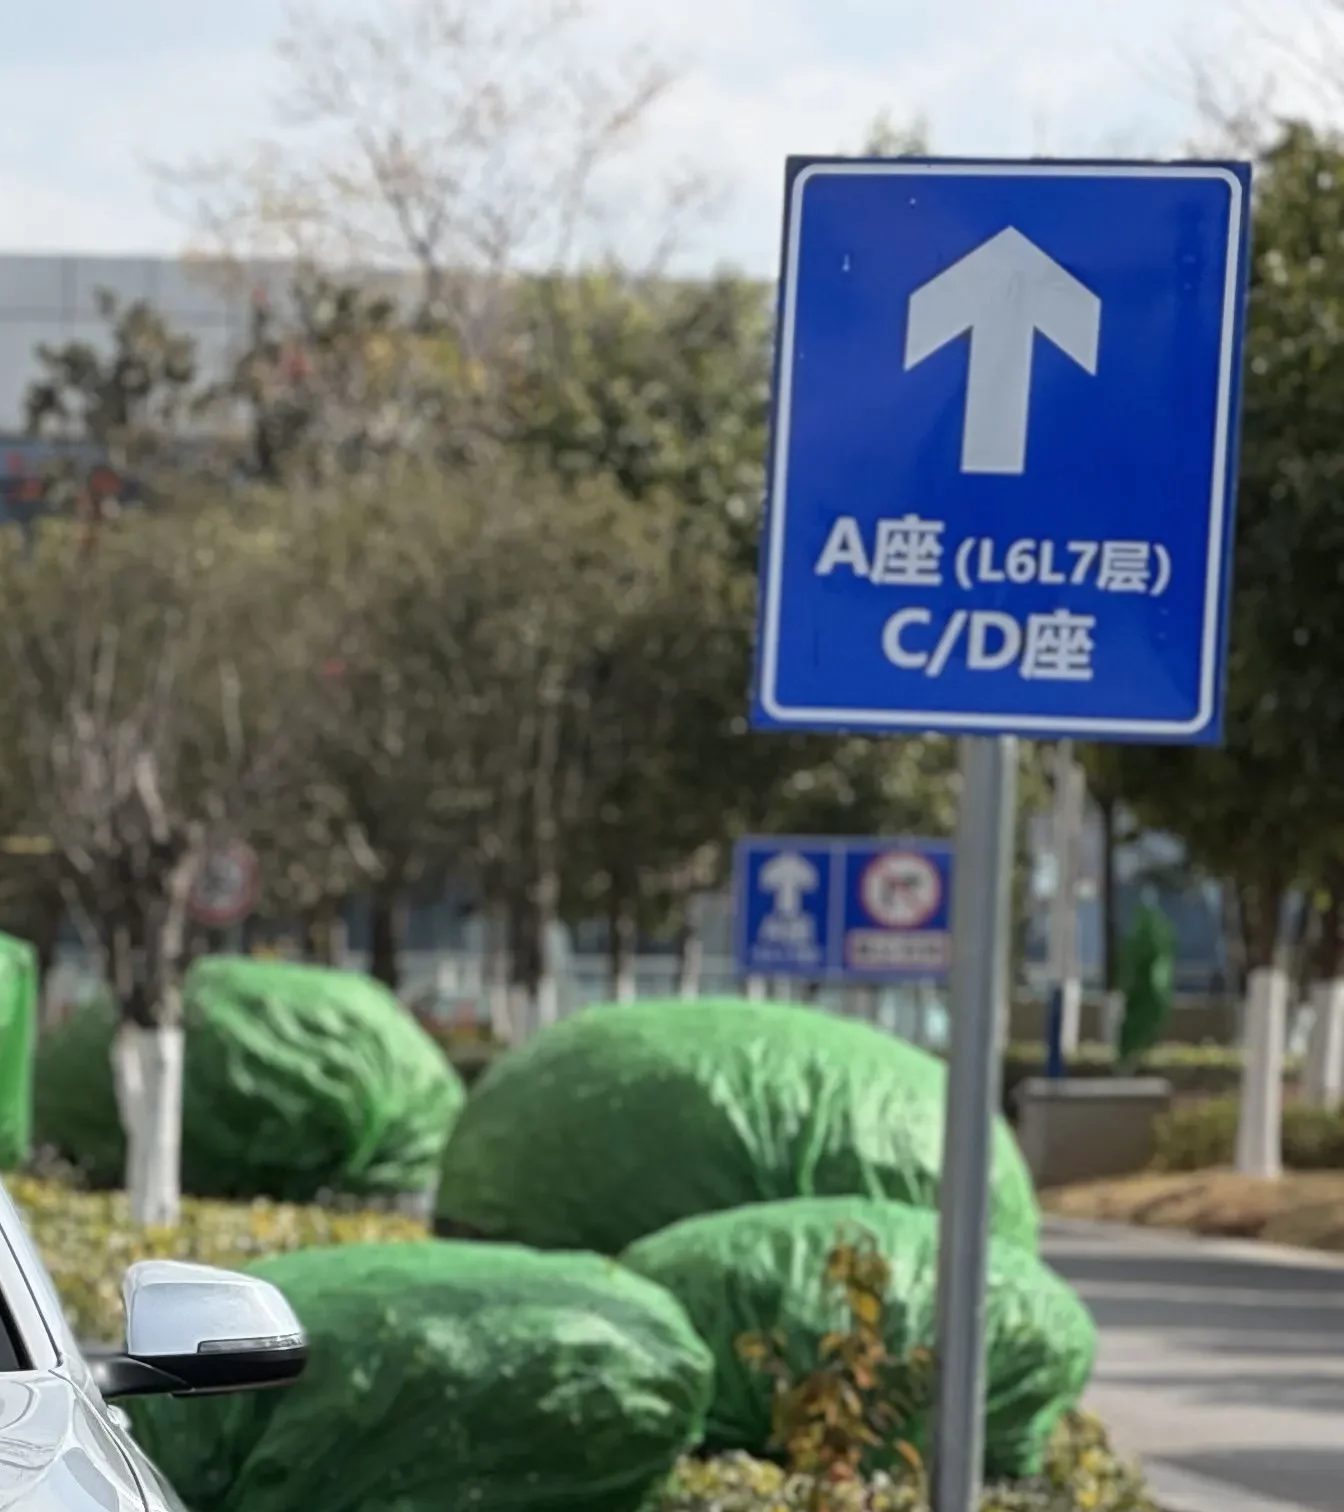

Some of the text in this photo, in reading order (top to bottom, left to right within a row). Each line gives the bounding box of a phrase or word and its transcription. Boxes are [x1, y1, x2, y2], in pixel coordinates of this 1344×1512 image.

[815, 514, 1171, 596] A座 (L6L7层)
[881, 607, 1096, 681] C/D座
